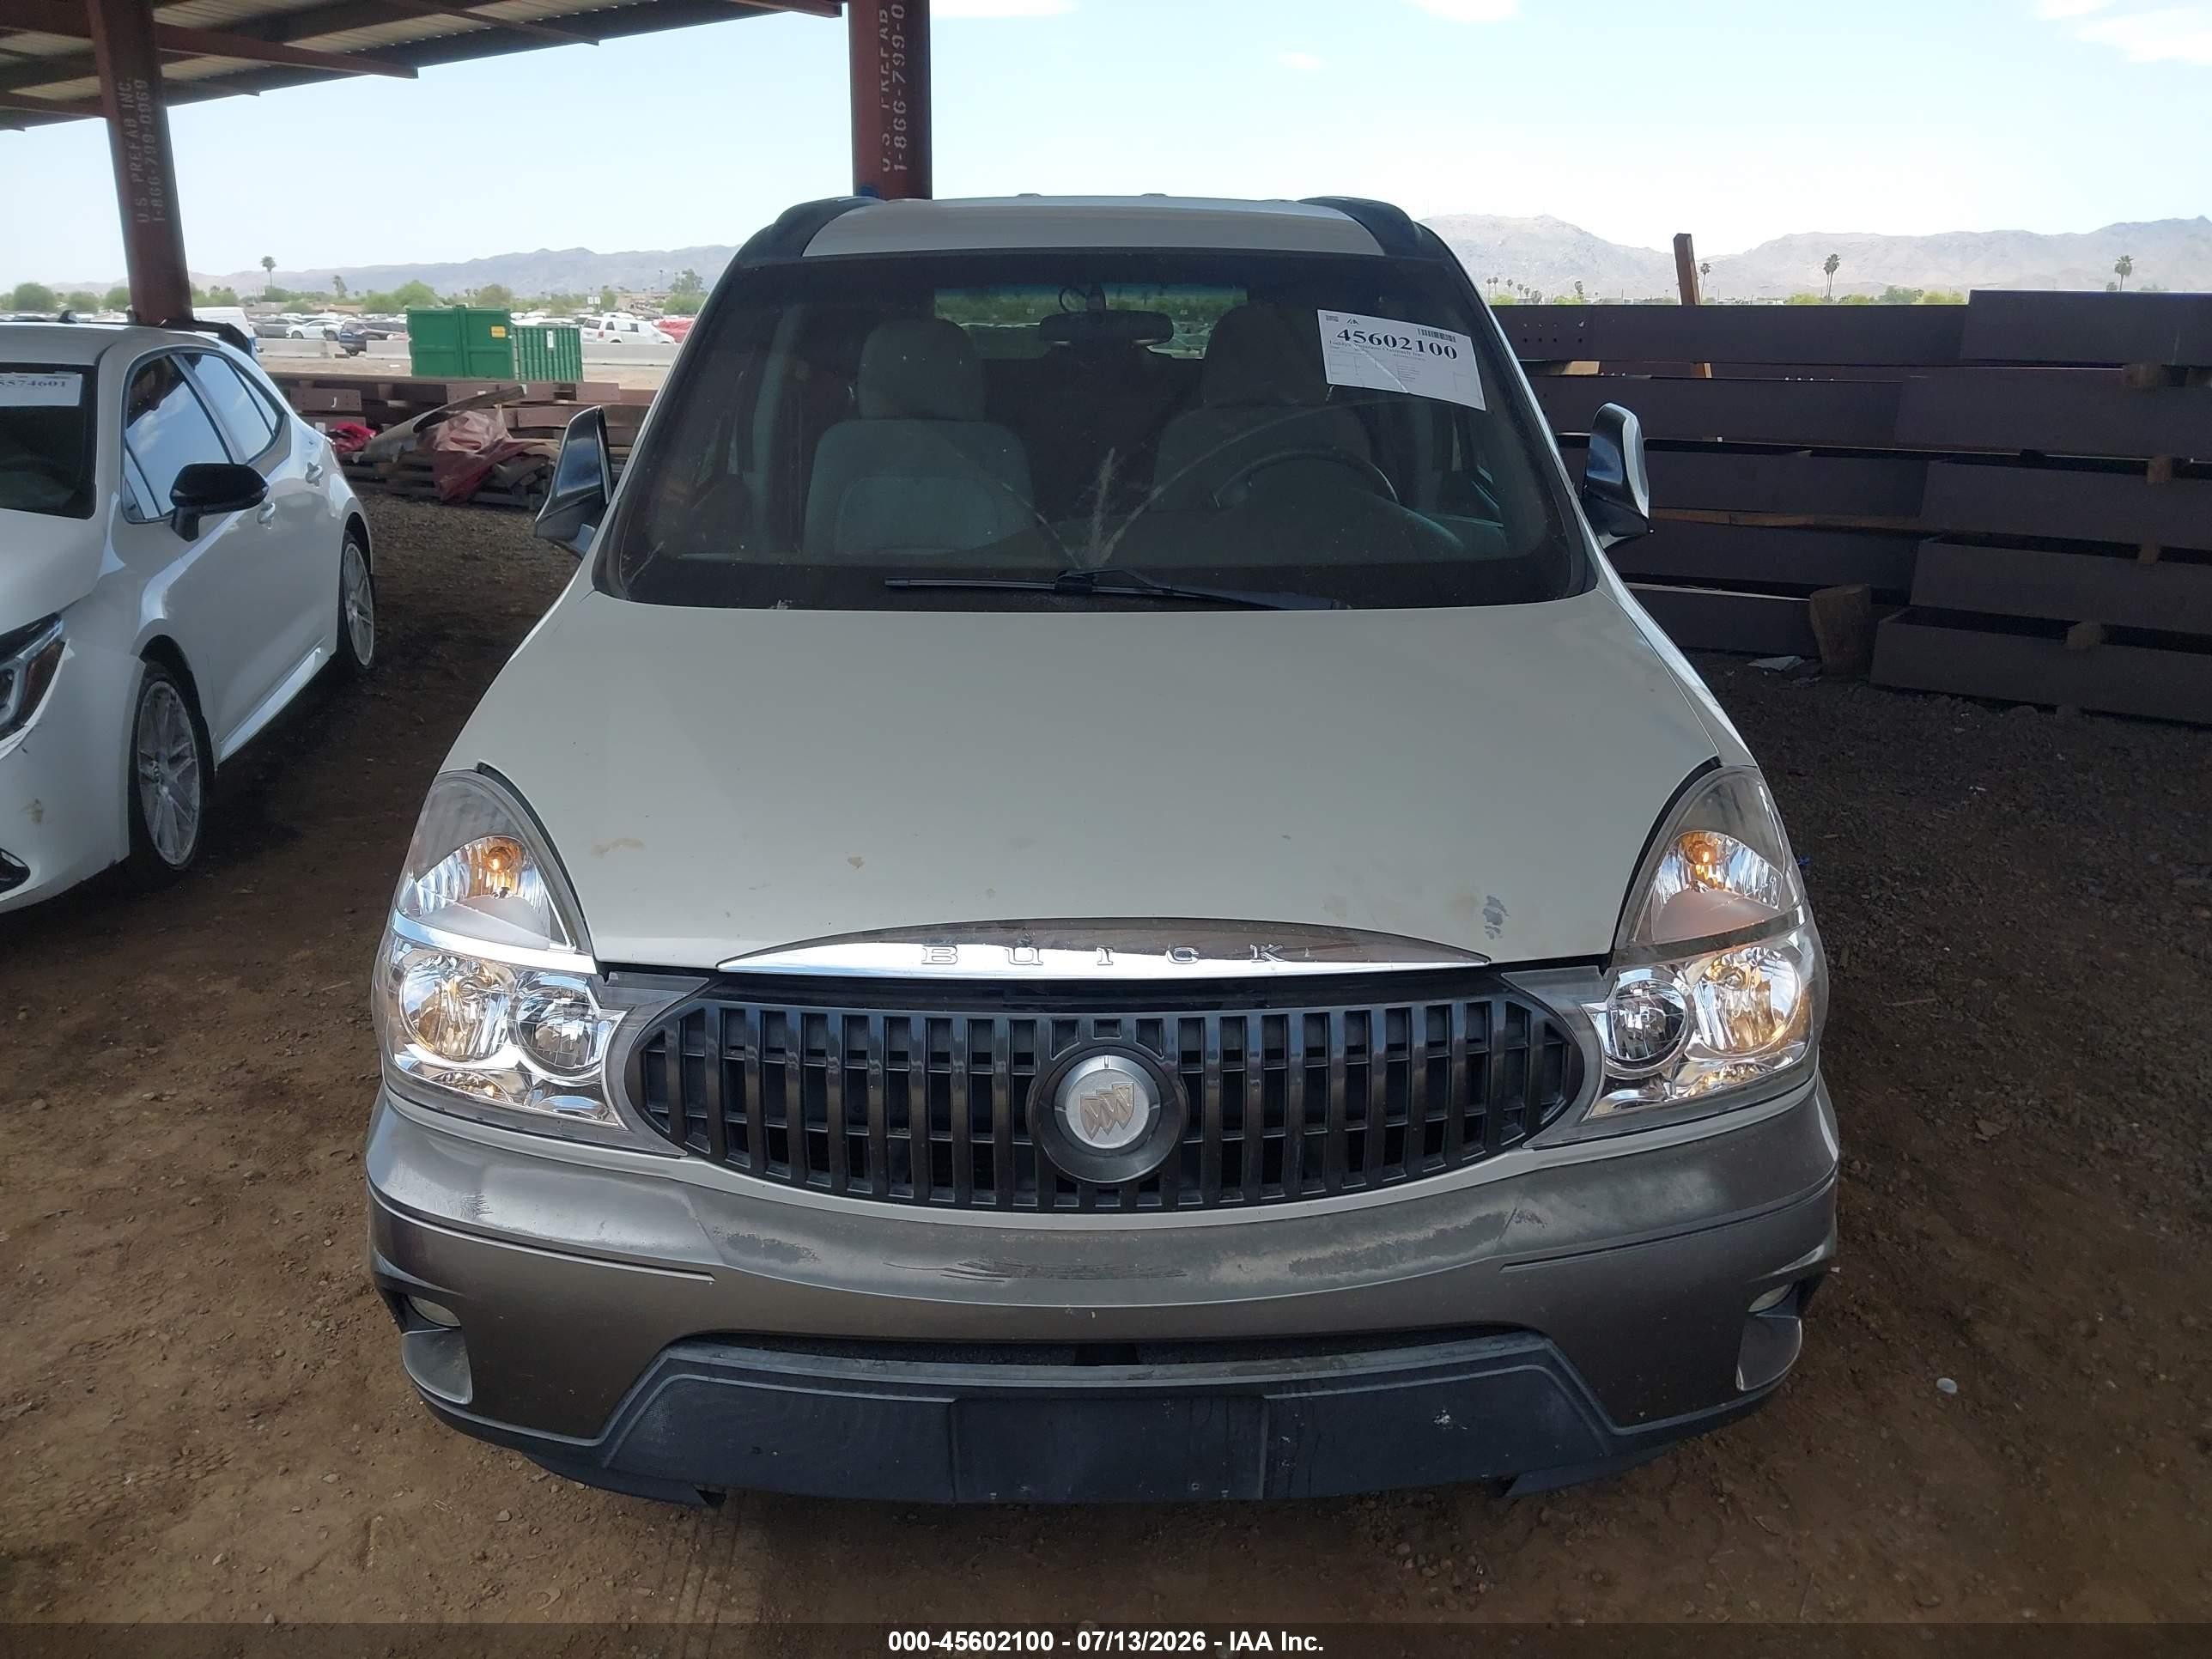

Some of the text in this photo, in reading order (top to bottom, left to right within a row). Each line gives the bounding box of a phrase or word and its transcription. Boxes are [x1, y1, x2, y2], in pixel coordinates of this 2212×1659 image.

[124, 118, 145, 183] PREFAB
[1336, 328, 1458, 360] 45602100
[921, 943, 1285, 965] BUICK
